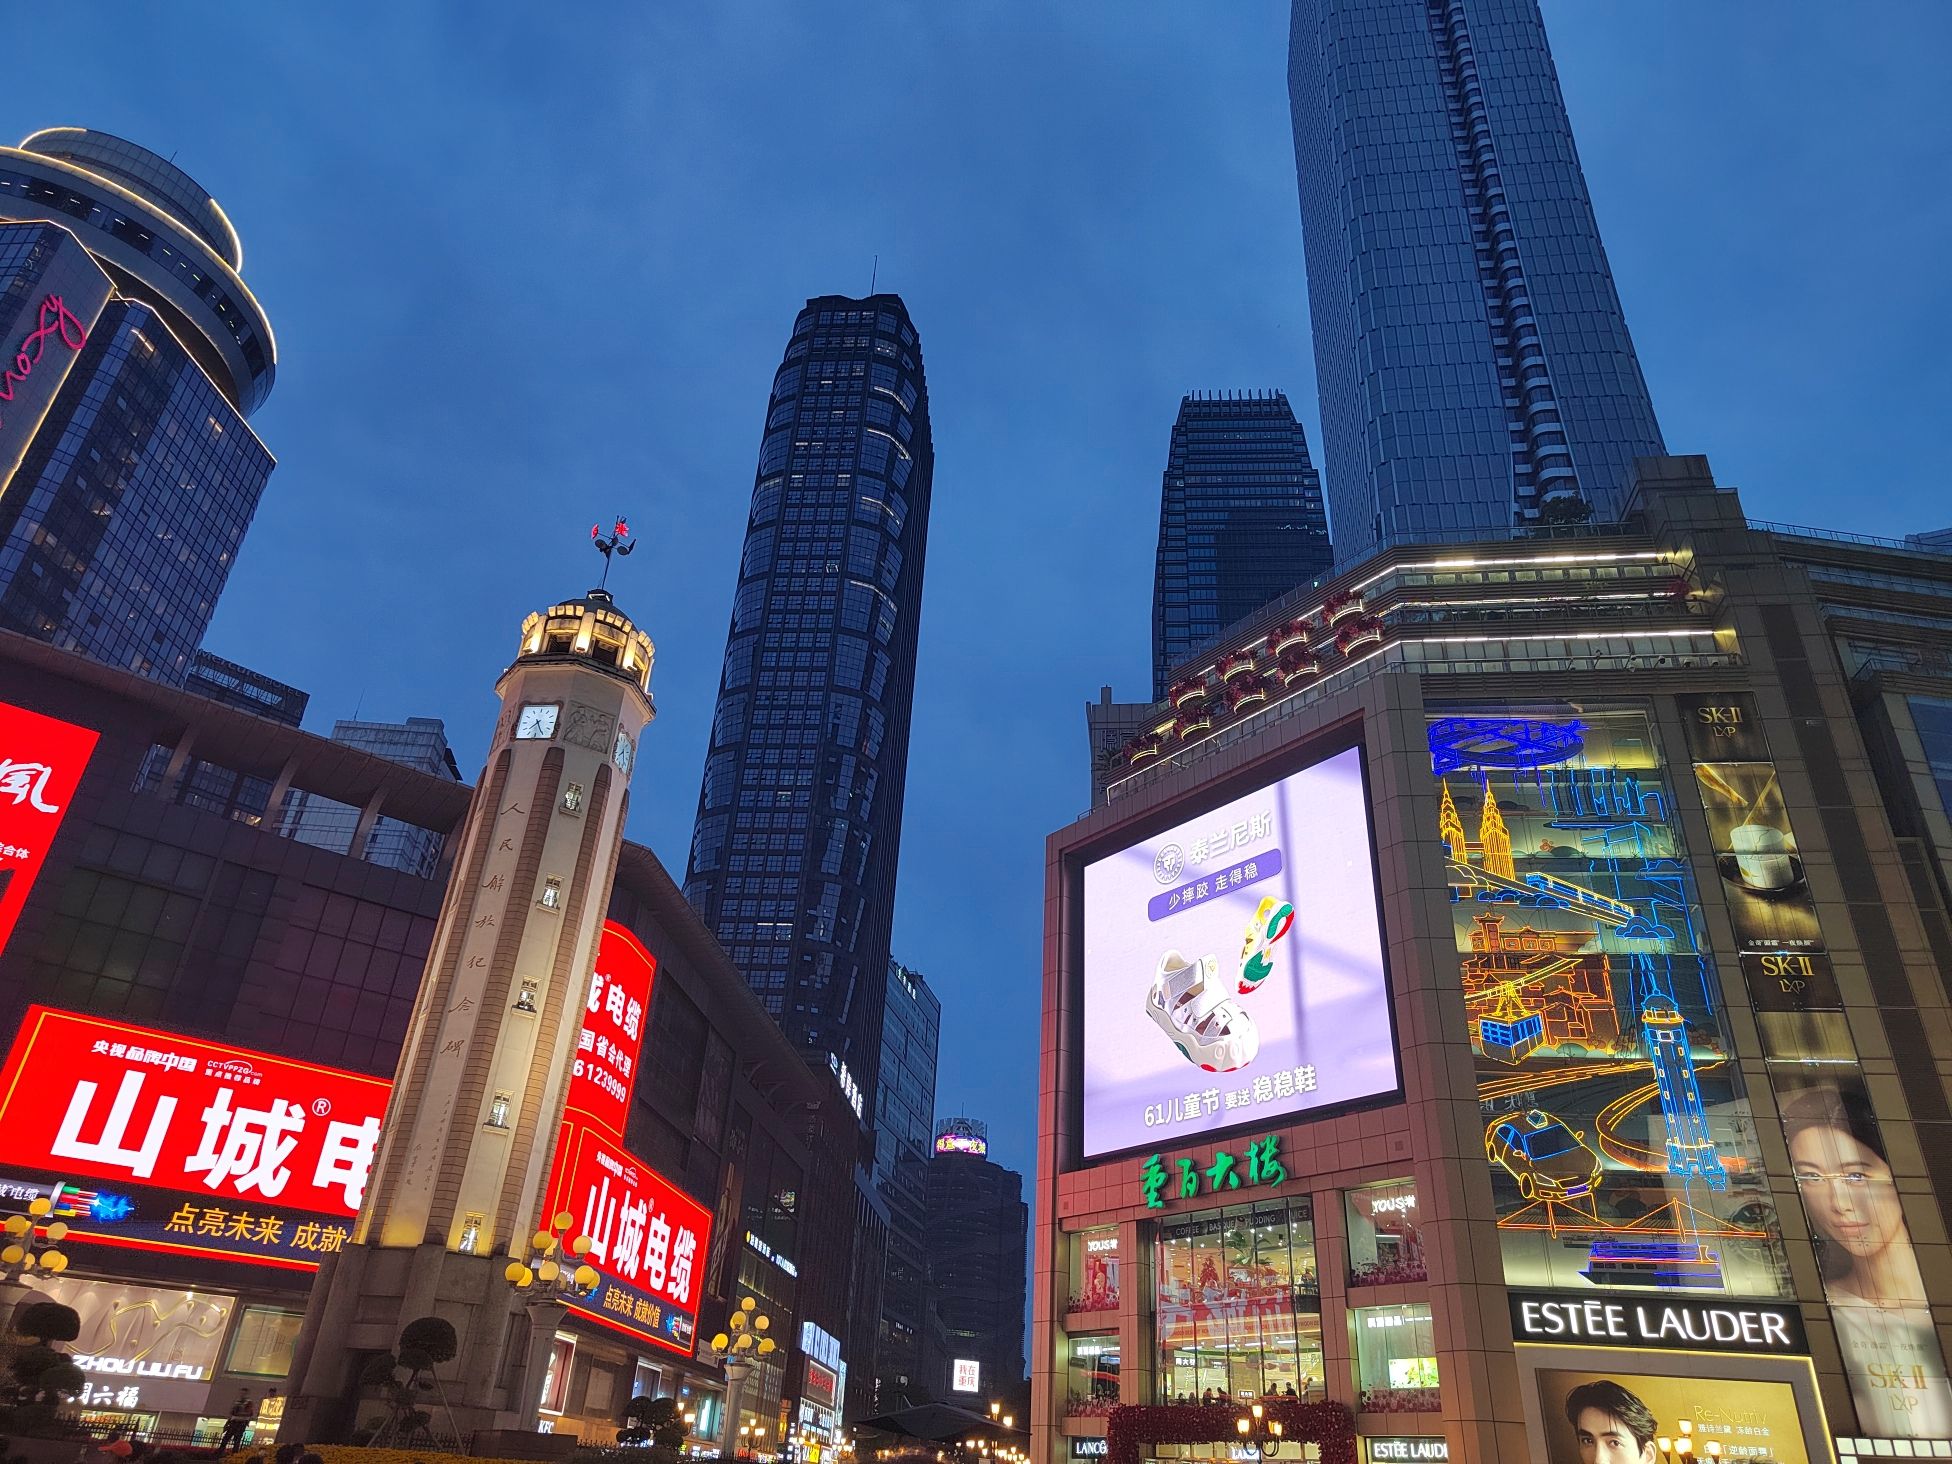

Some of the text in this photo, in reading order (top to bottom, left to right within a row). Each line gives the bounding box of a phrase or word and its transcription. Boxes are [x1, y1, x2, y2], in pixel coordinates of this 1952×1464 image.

[1697, 706, 1745, 724] SK-II
[1188, 808, 1274, 866] 泰兰尼斯
[1167, 862, 1260, 911] 少摔跤 走得稳
[1760, 955, 1815, 976] SK-II
[1778, 978, 1806, 995] LXP
[90, 1039, 198, 1074] 央视品牌中国
[1143, 1087, 1221, 1129] 61儿童节
[1251, 1064, 1318, 1103] 稳稳鞋
[1139, 1134, 1289, 1210] 重百大楼
[1291, 1208, 1308, 1219] UICE
[164, 1202, 348, 1255] 点亮未来 成就
[1637, 1306, 1791, 1345] LAUDER
[72, 1354, 136, 1374] ZHOU
[173, 1364, 204, 1380] FU
[538, 1419, 555, 1434] KFC
[1697, 1423, 1733, 1435] 雅诗兰黛
[1075, 1441, 1108, 1455] LANCÔ
